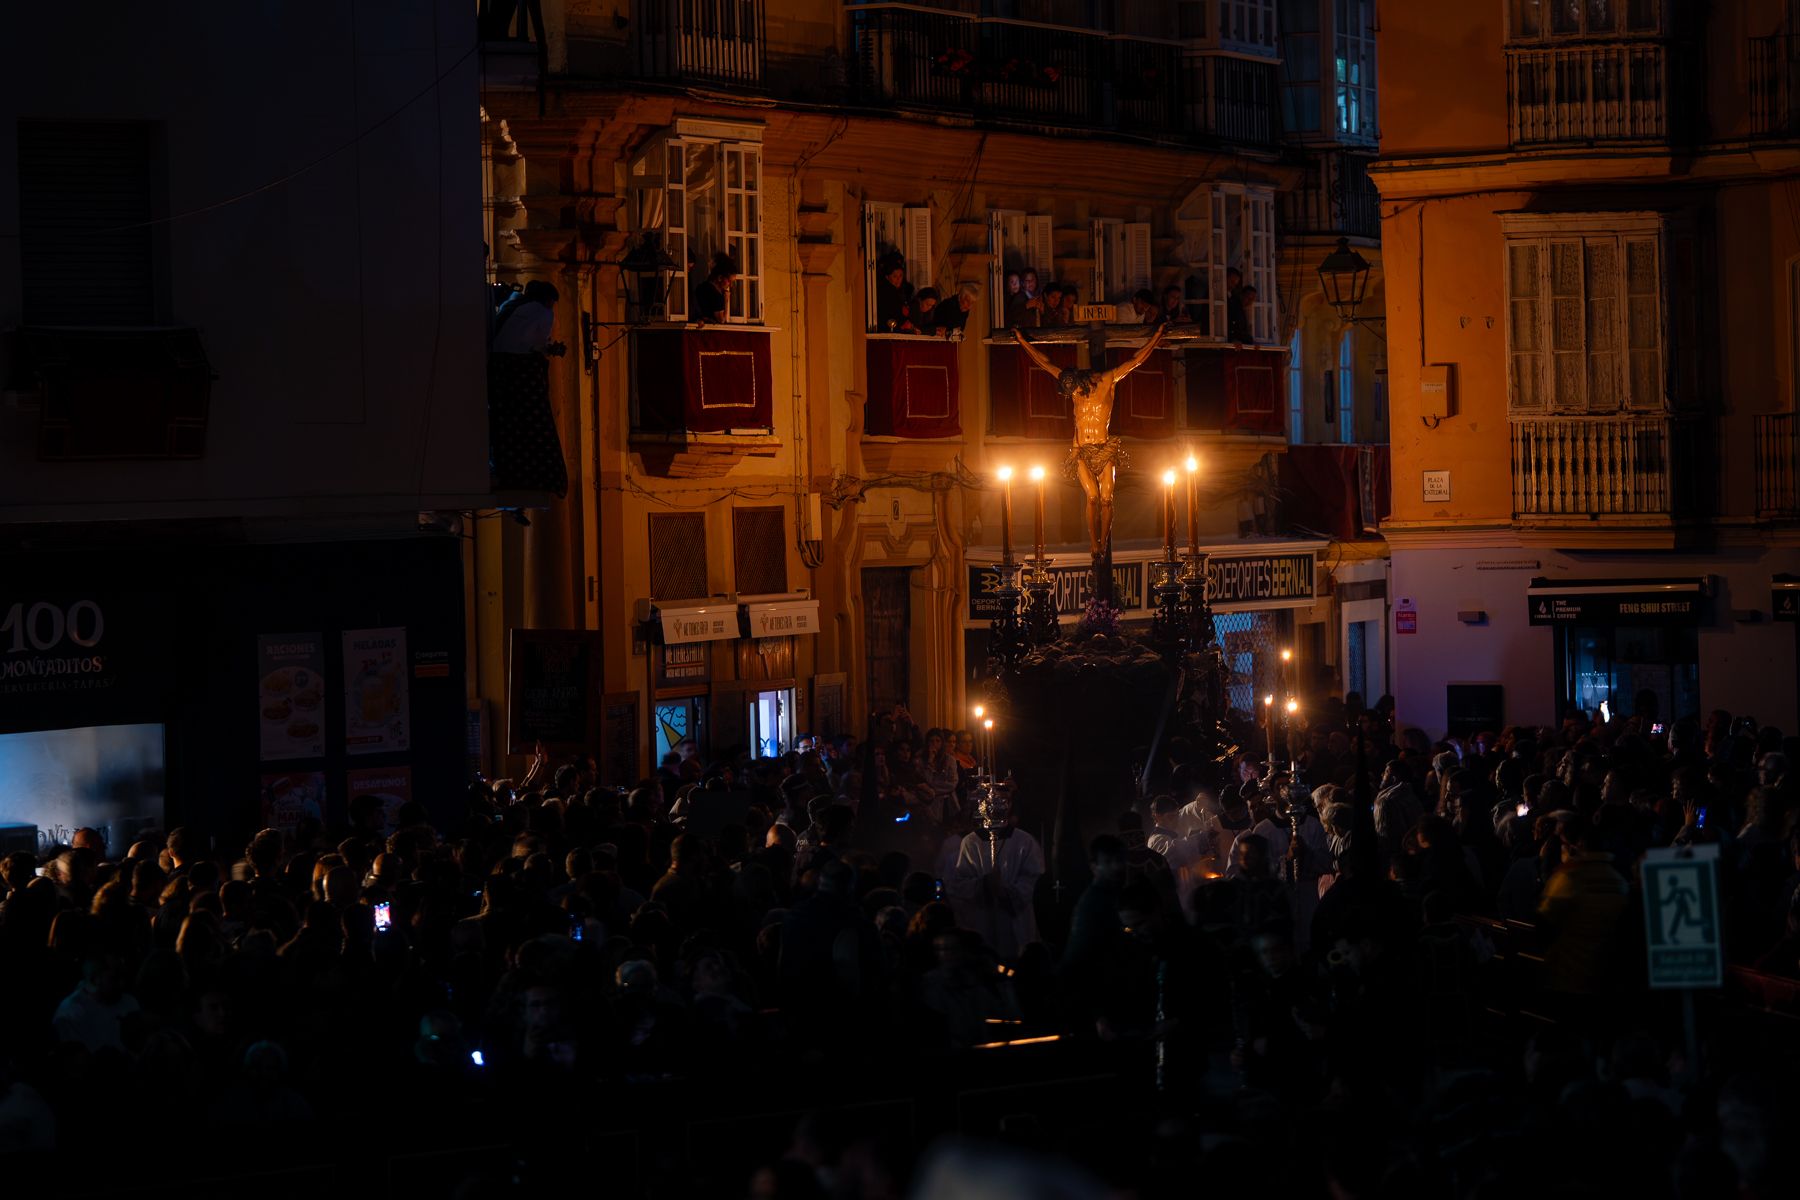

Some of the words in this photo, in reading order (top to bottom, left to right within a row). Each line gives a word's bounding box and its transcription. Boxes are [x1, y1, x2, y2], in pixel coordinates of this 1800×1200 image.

[1218, 558, 1270, 600] DEPORTES
[1271, 553, 1312, 598] BERNAL
[0, 600, 104, 653] 100
[1619, 603, 1639, 614] FENG
[1641, 602, 1659, 613] SHUI
[1661, 602, 1690, 612] STREET
